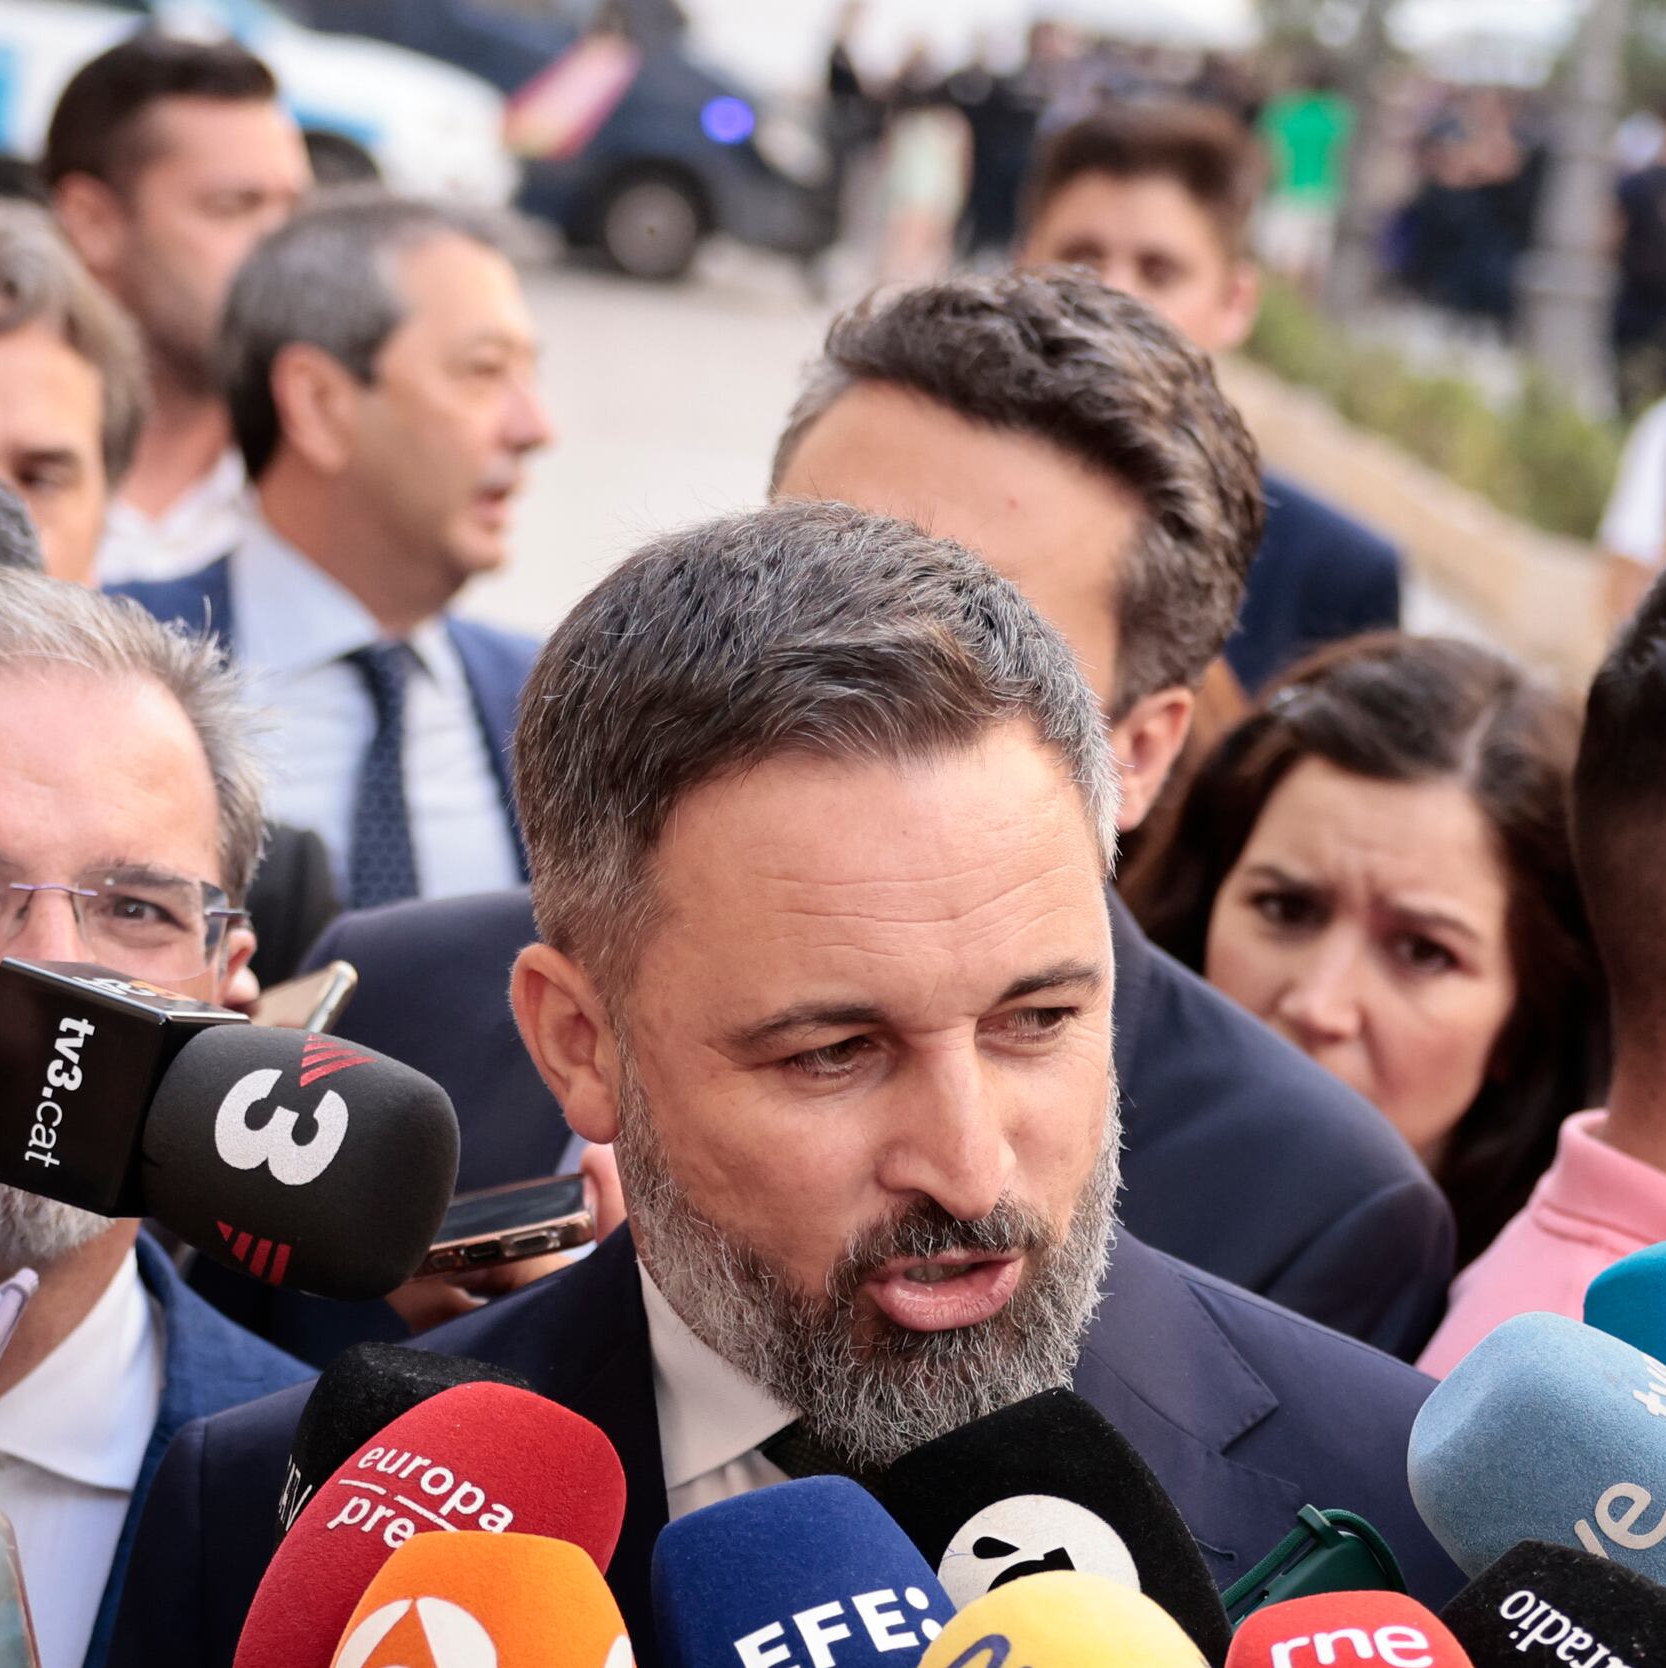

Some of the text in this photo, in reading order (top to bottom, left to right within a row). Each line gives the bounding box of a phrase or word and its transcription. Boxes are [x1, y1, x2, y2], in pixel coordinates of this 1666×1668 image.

[24, 1017, 95, 1168] tv3.cat
[215, 1068, 349, 1186] 3
[326, 1496, 416, 1549] pre
[358, 1447, 514, 1533] europa
